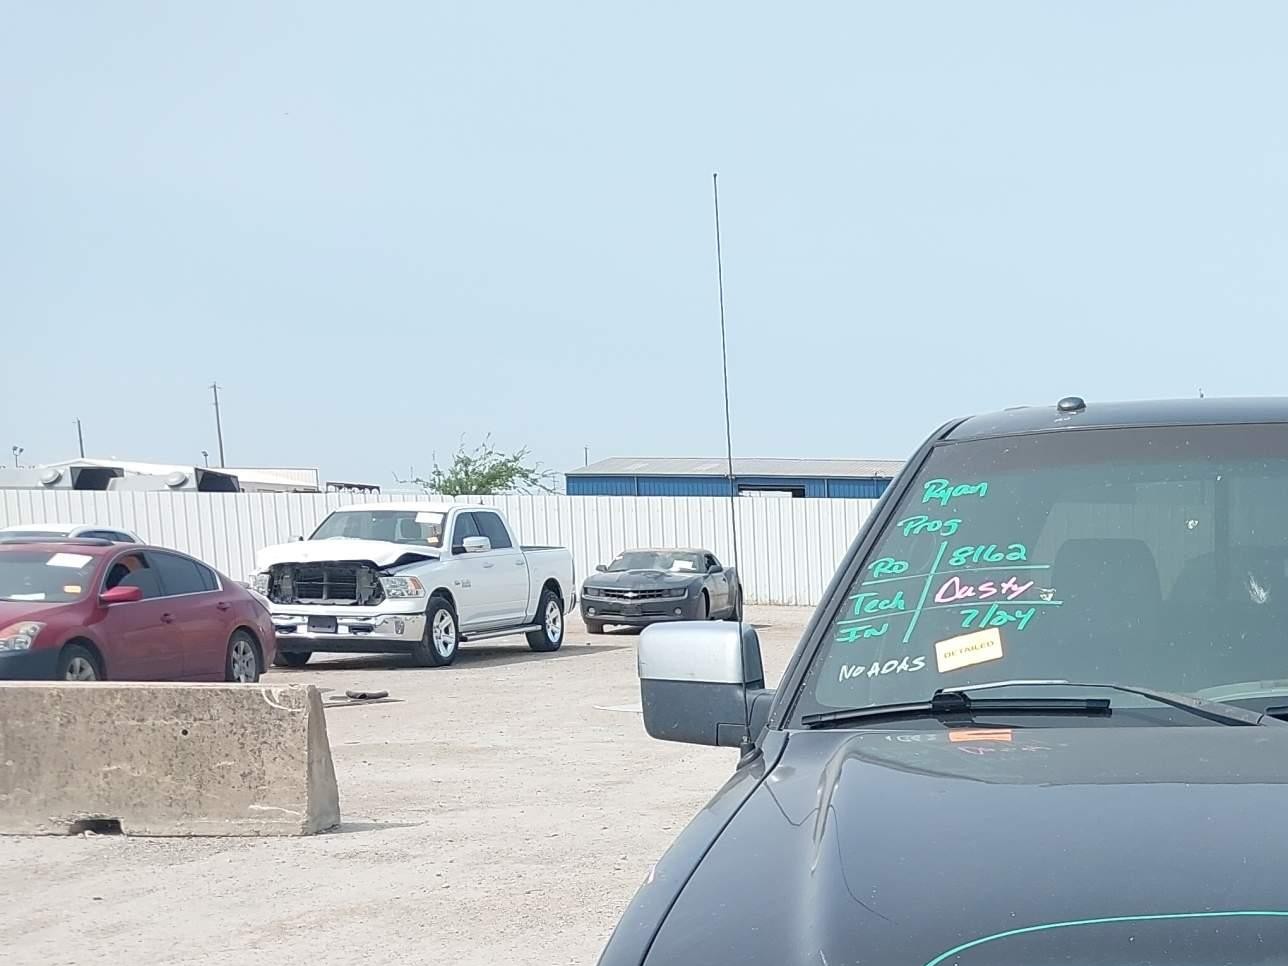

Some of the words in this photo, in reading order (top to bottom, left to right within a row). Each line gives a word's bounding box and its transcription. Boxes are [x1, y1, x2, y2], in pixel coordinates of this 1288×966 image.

[922, 478, 988, 506] Ryan
[949, 543, 1027, 566] 8162
[849, 591, 905, 615] Tech
[934, 576, 1034, 603] Dusty
[960, 602, 1036, 630] 7/24
[943, 640, 995, 659] DETAILED
